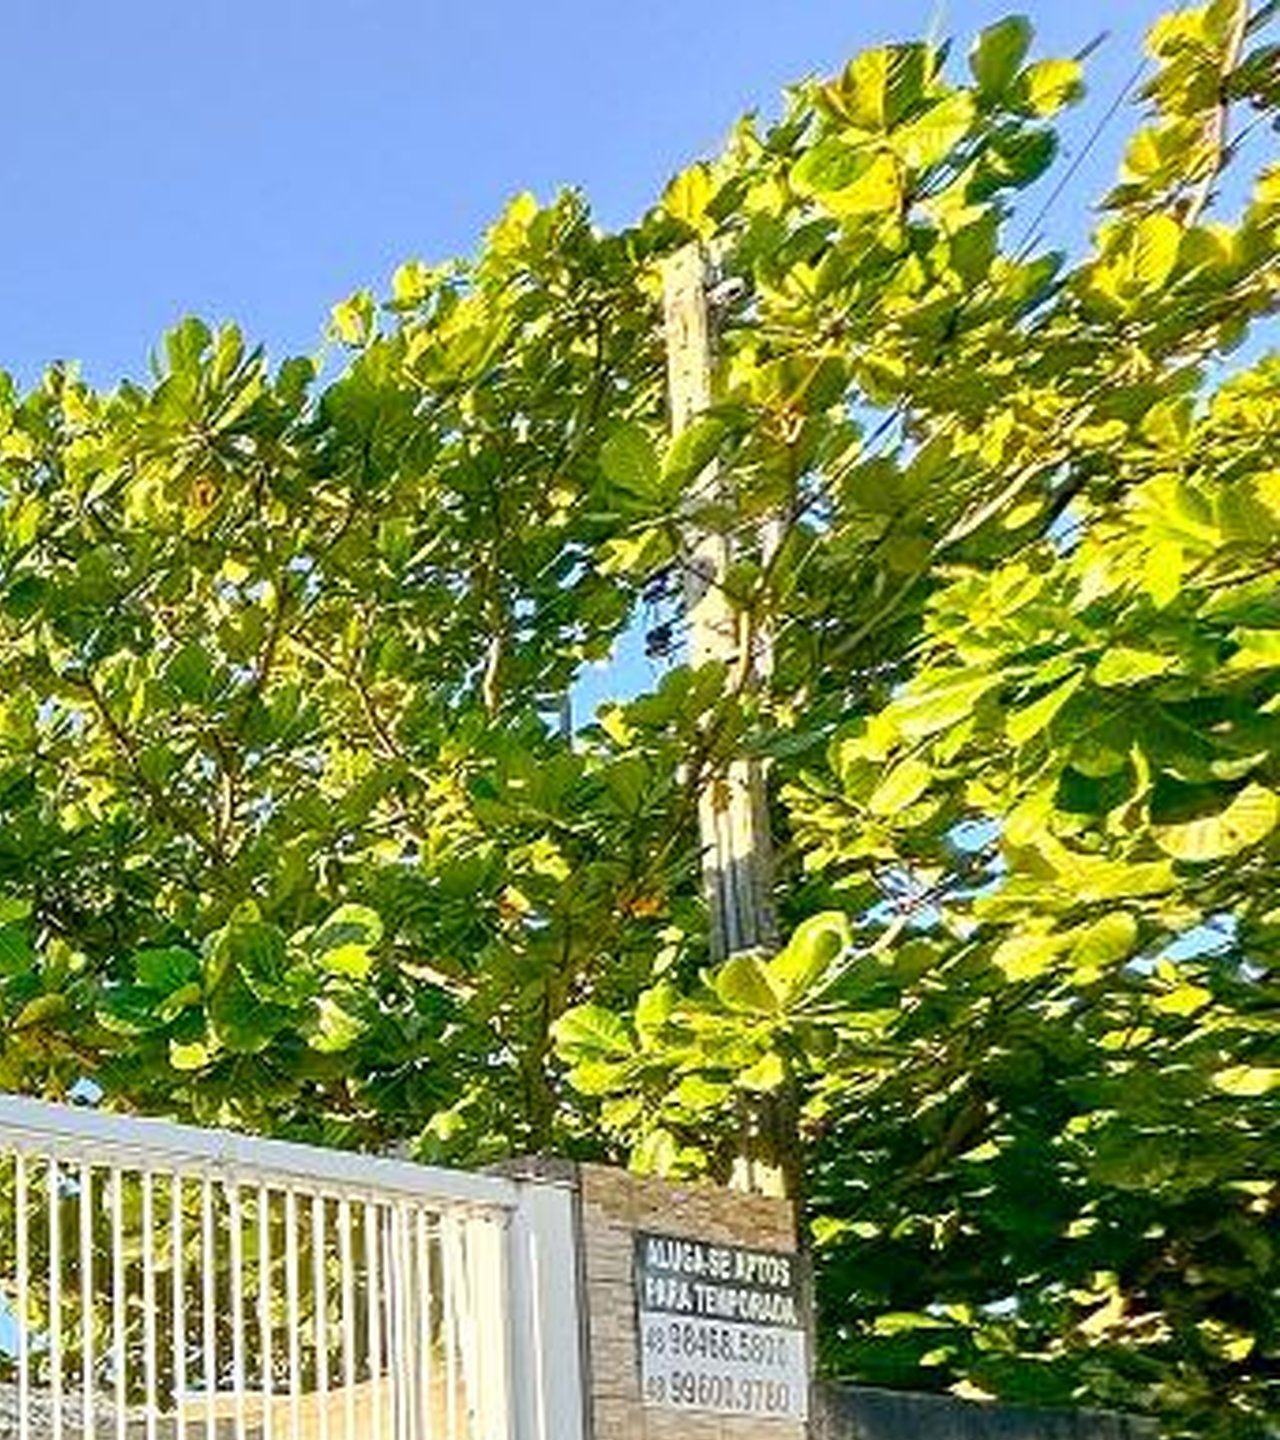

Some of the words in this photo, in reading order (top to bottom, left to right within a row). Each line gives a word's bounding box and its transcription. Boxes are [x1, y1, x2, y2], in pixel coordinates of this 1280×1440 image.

[734, 1252, 791, 1287] APTOS
[645, 1277, 692, 1311] PARA
[694, 1284, 798, 1325] TEMPORADA
